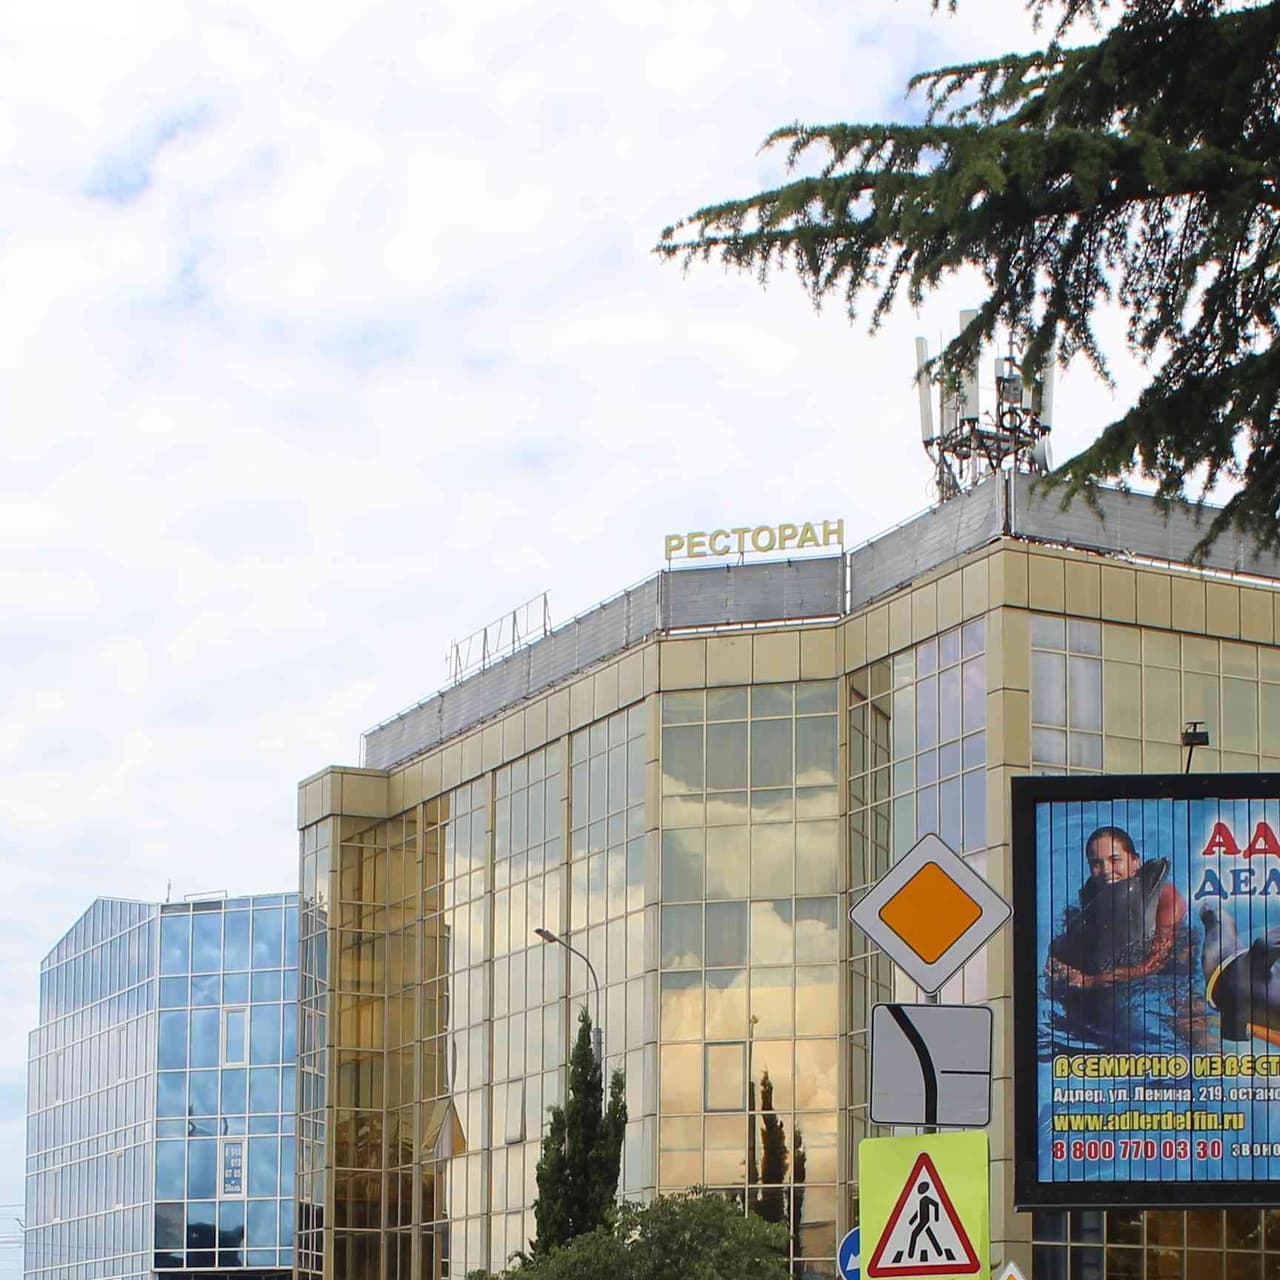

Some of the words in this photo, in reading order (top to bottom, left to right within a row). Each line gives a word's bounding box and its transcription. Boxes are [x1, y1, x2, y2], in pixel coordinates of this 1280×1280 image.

[664, 518, 845, 560] РЕСТОРАН
[1054, 1054, 1189, 1079] ВСЕМИРНО
[1053, 1087, 1106, 1103] Адлер,
[1109, 1089, 1129, 1103] ул.
[1133, 1087, 1195, 1102] Ленина,
[1198, 1086, 1227, 1102] 219,
[1053, 1110, 1245, 1132] www.adlerdelfin.ru
[1053, 1140, 1066, 1160] 8
[1072, 1140, 1114, 1160] 800
[1119, 1140, 1157, 1160] 770
[1161, 1139, 1190, 1160] 03
[1196, 1139, 1222, 1160] 30
